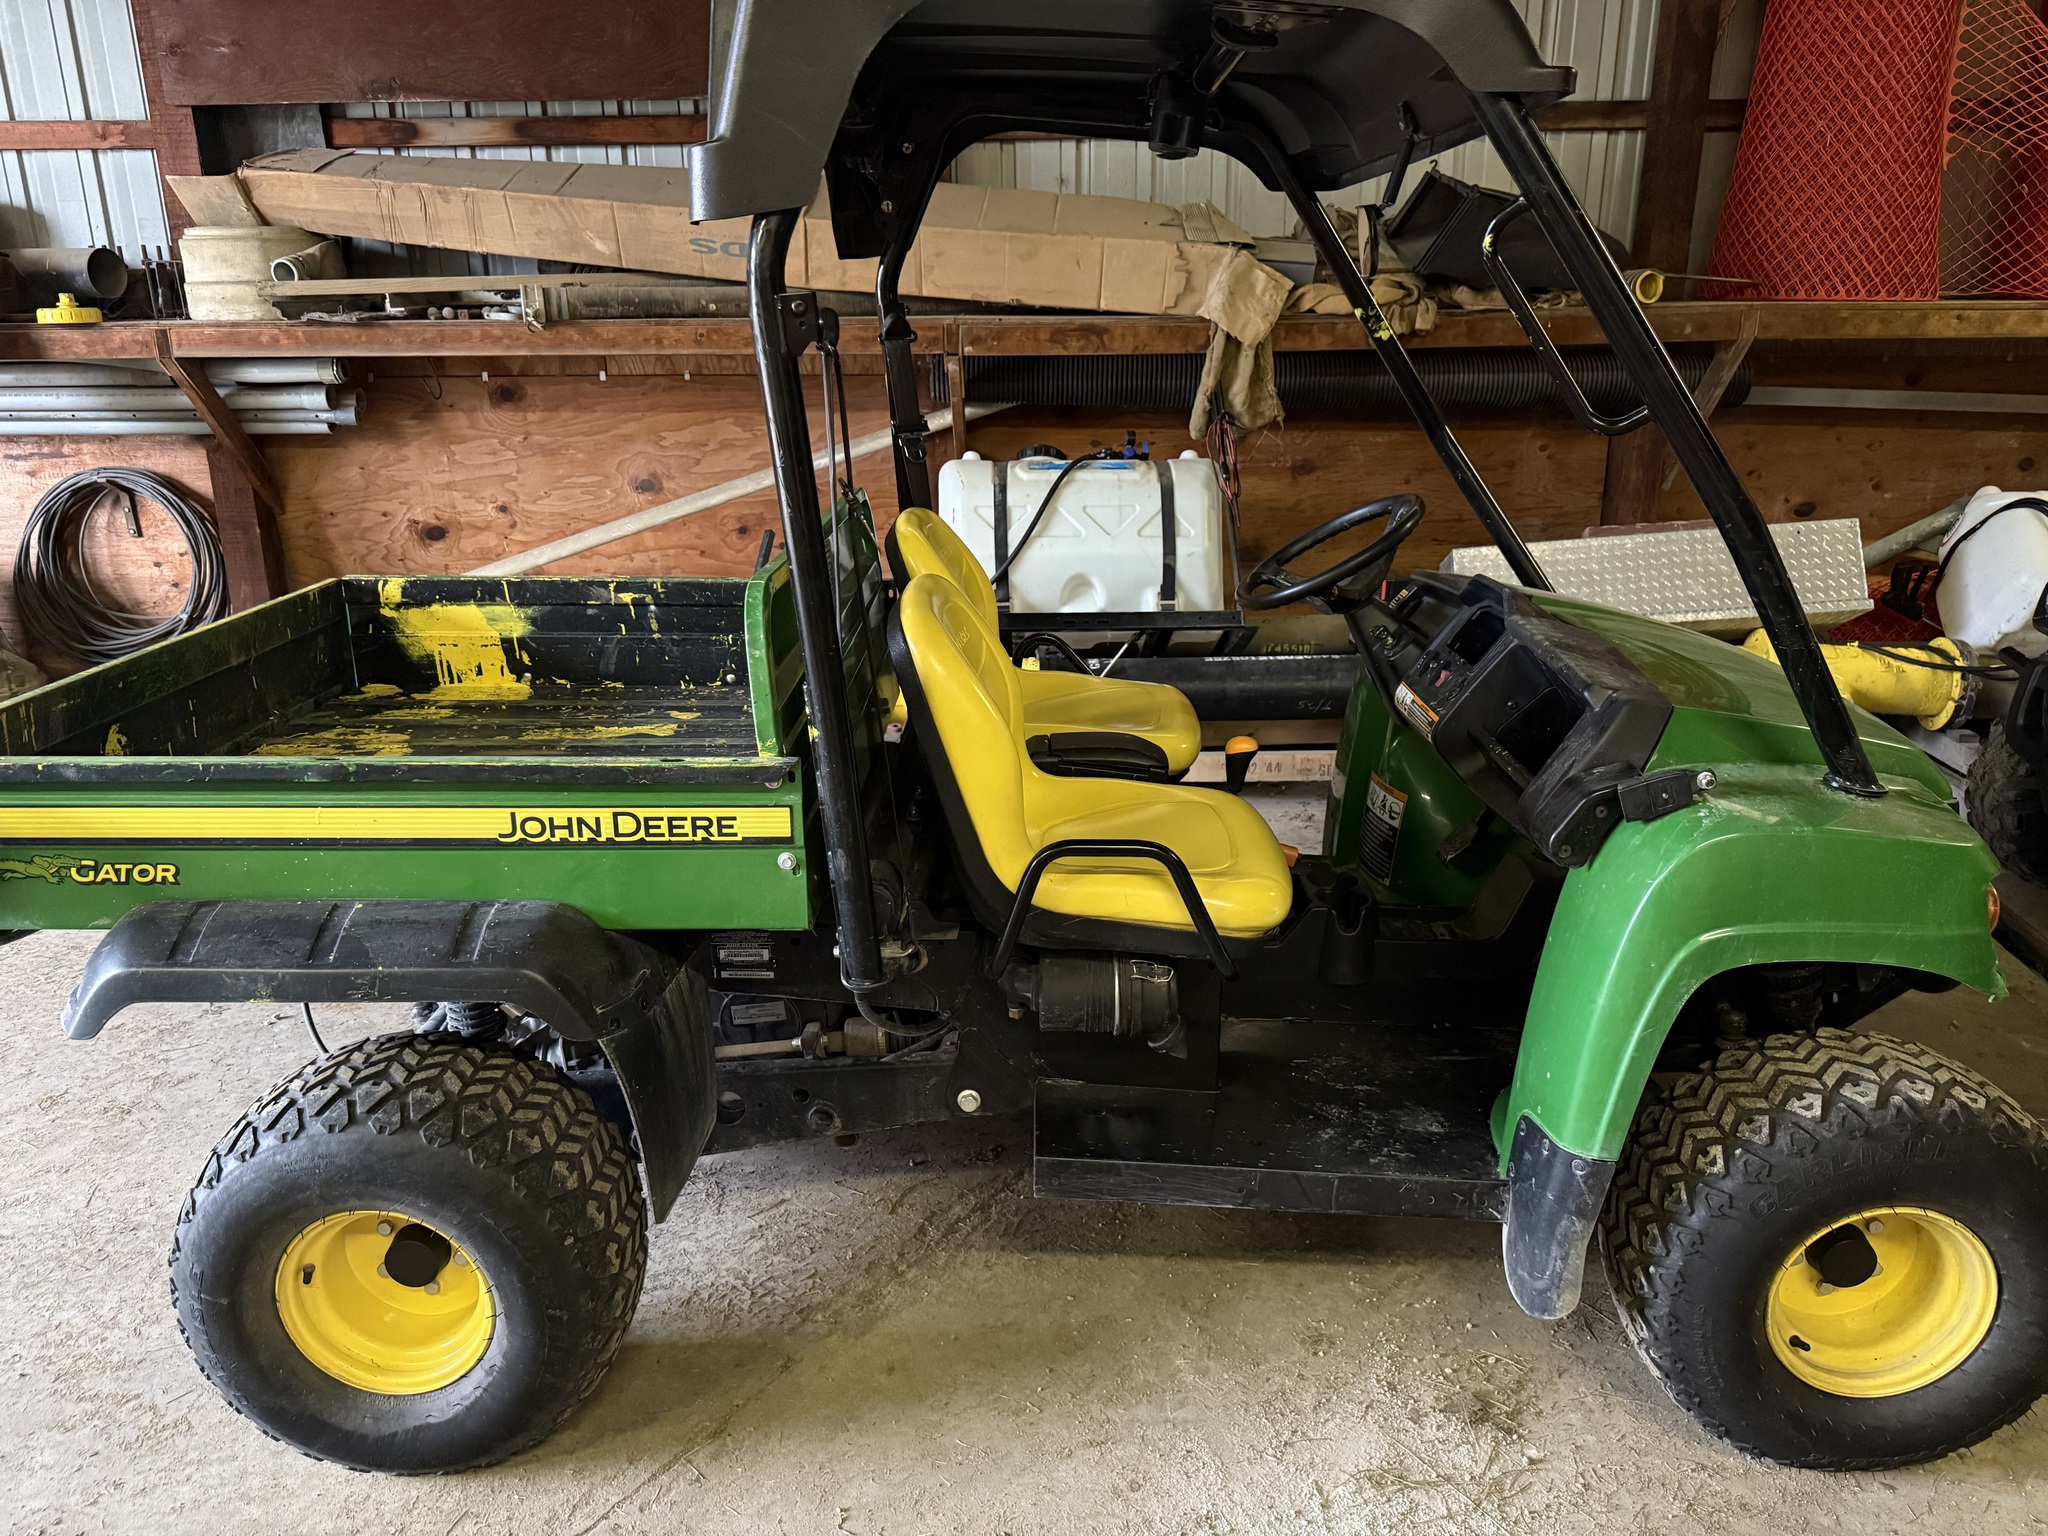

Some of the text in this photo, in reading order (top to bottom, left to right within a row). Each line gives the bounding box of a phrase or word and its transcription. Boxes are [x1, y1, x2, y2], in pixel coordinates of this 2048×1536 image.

[499, 811, 738, 839] JOHN DEERE
[70, 860, 177, 884] GATOR
